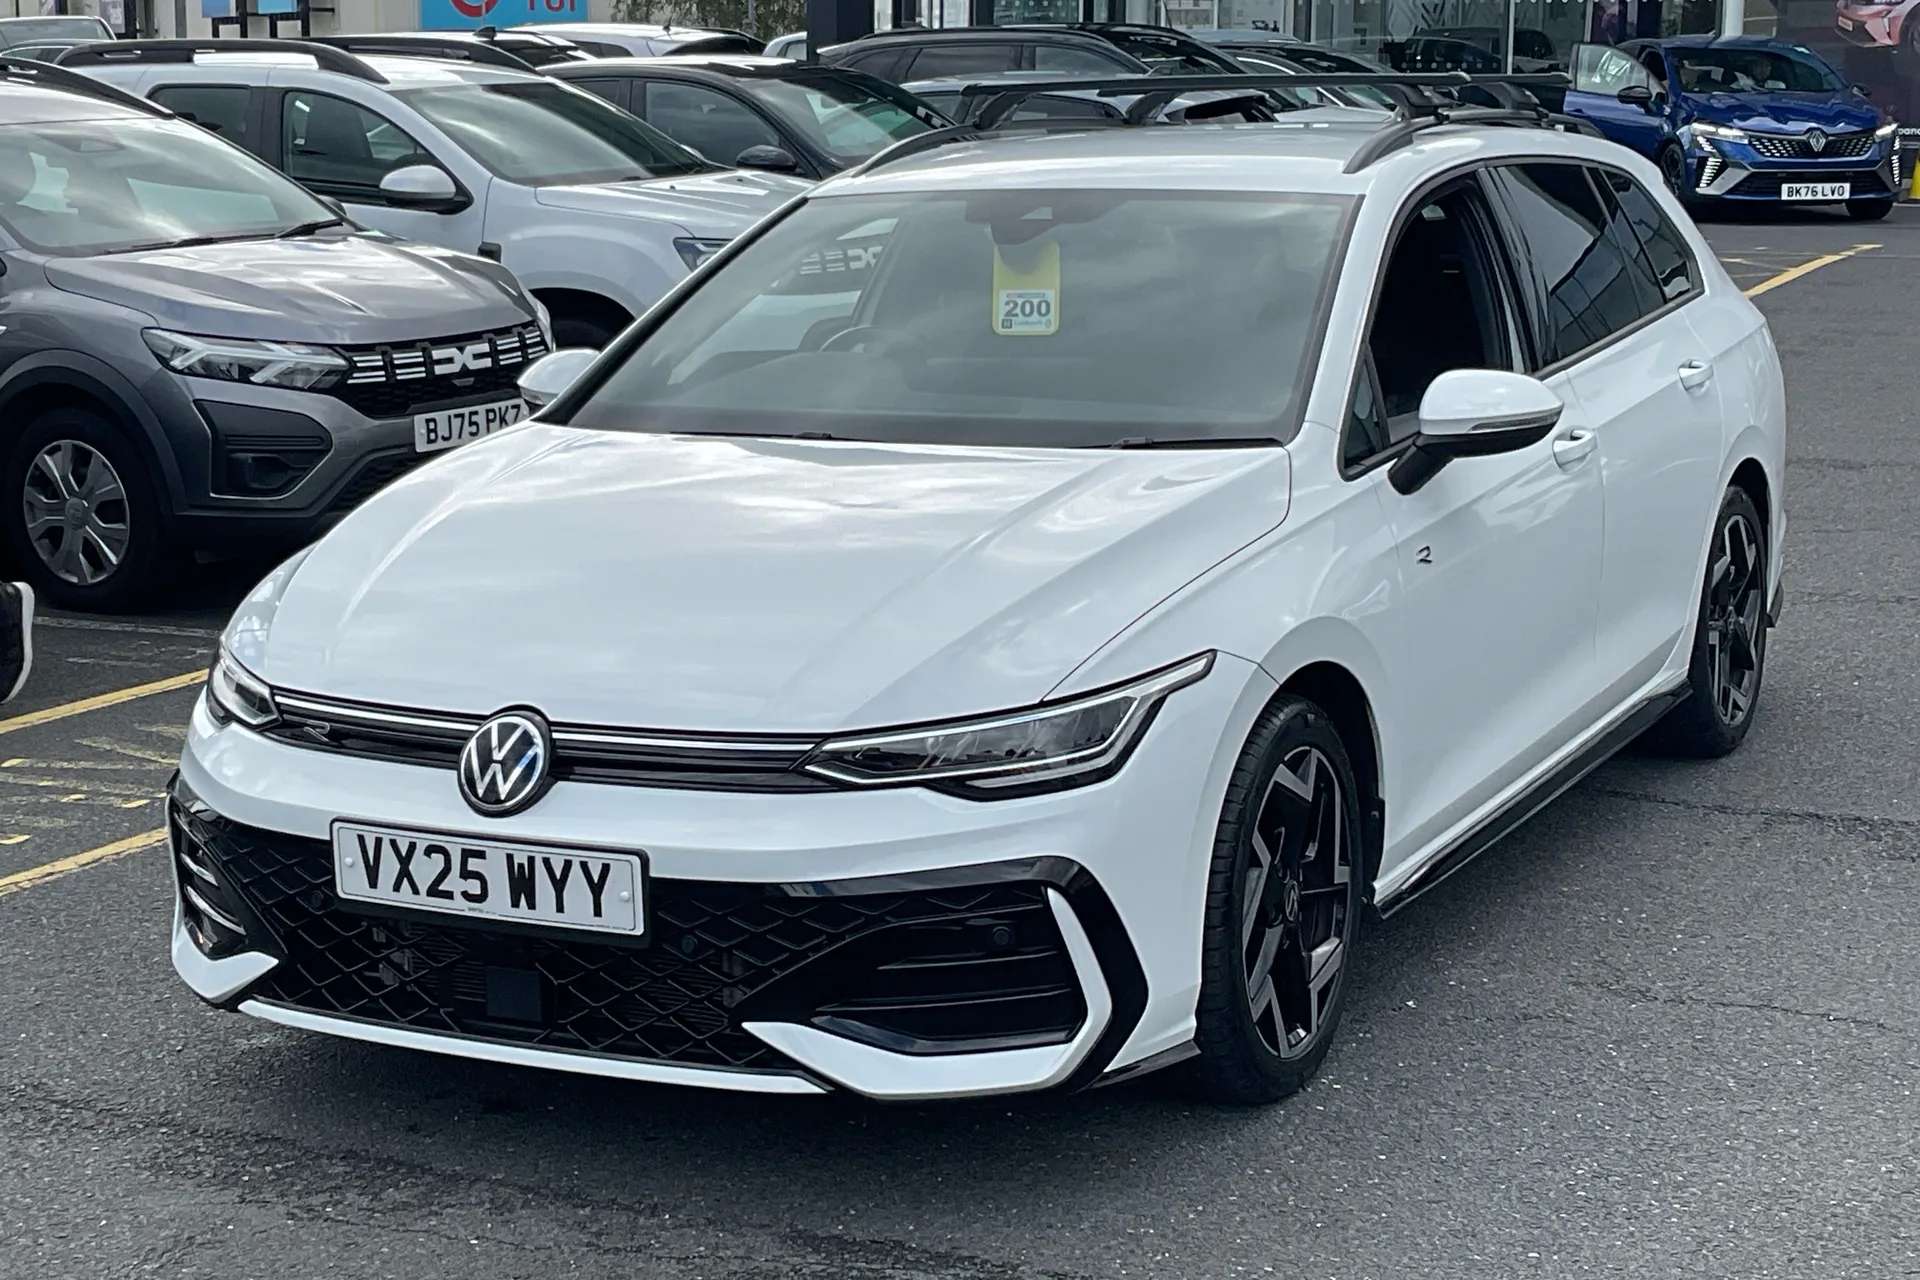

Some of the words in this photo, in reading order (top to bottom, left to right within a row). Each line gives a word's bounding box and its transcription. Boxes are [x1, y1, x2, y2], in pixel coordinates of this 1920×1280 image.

[1787, 185, 1818, 198] BK76
[1004, 300, 1050, 317] 200
[425, 411, 480, 444] BJ75
[357, 834, 489, 904] VX25
[506, 853, 611, 918] WYY
